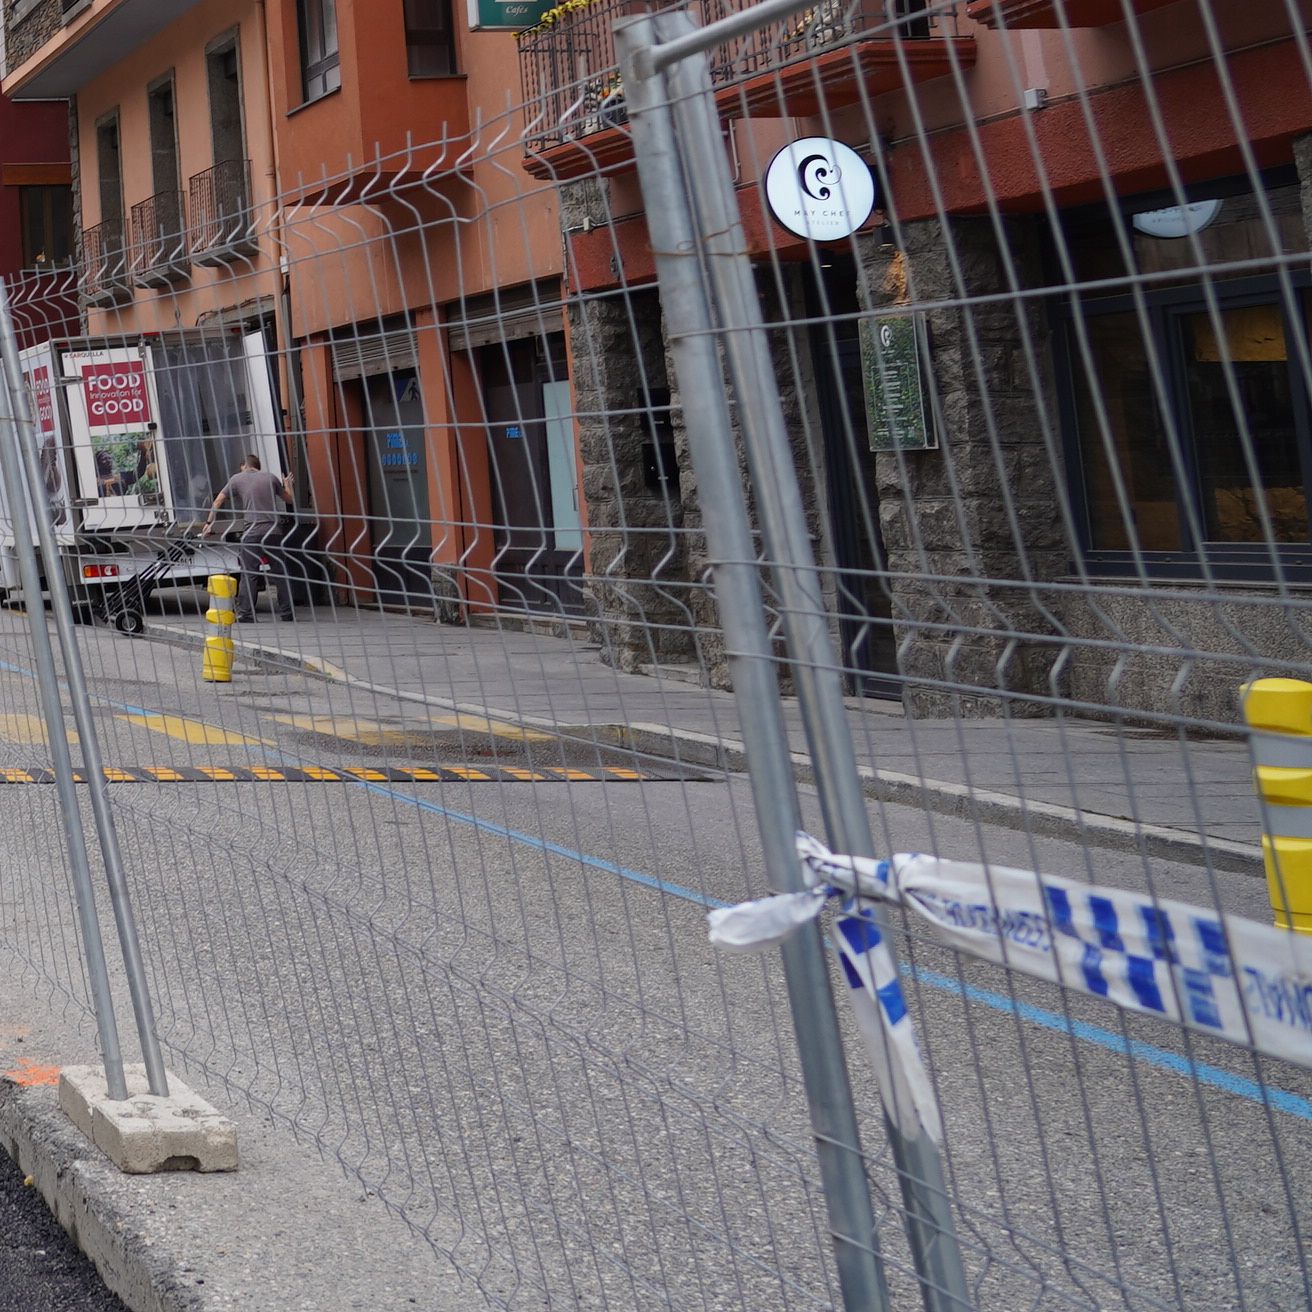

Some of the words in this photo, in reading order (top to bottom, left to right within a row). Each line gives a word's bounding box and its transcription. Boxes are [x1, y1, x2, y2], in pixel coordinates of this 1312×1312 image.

[88, 372, 141, 392] FOOD
[131, 388, 142, 397] for
[91, 398, 144, 415] GOOD
